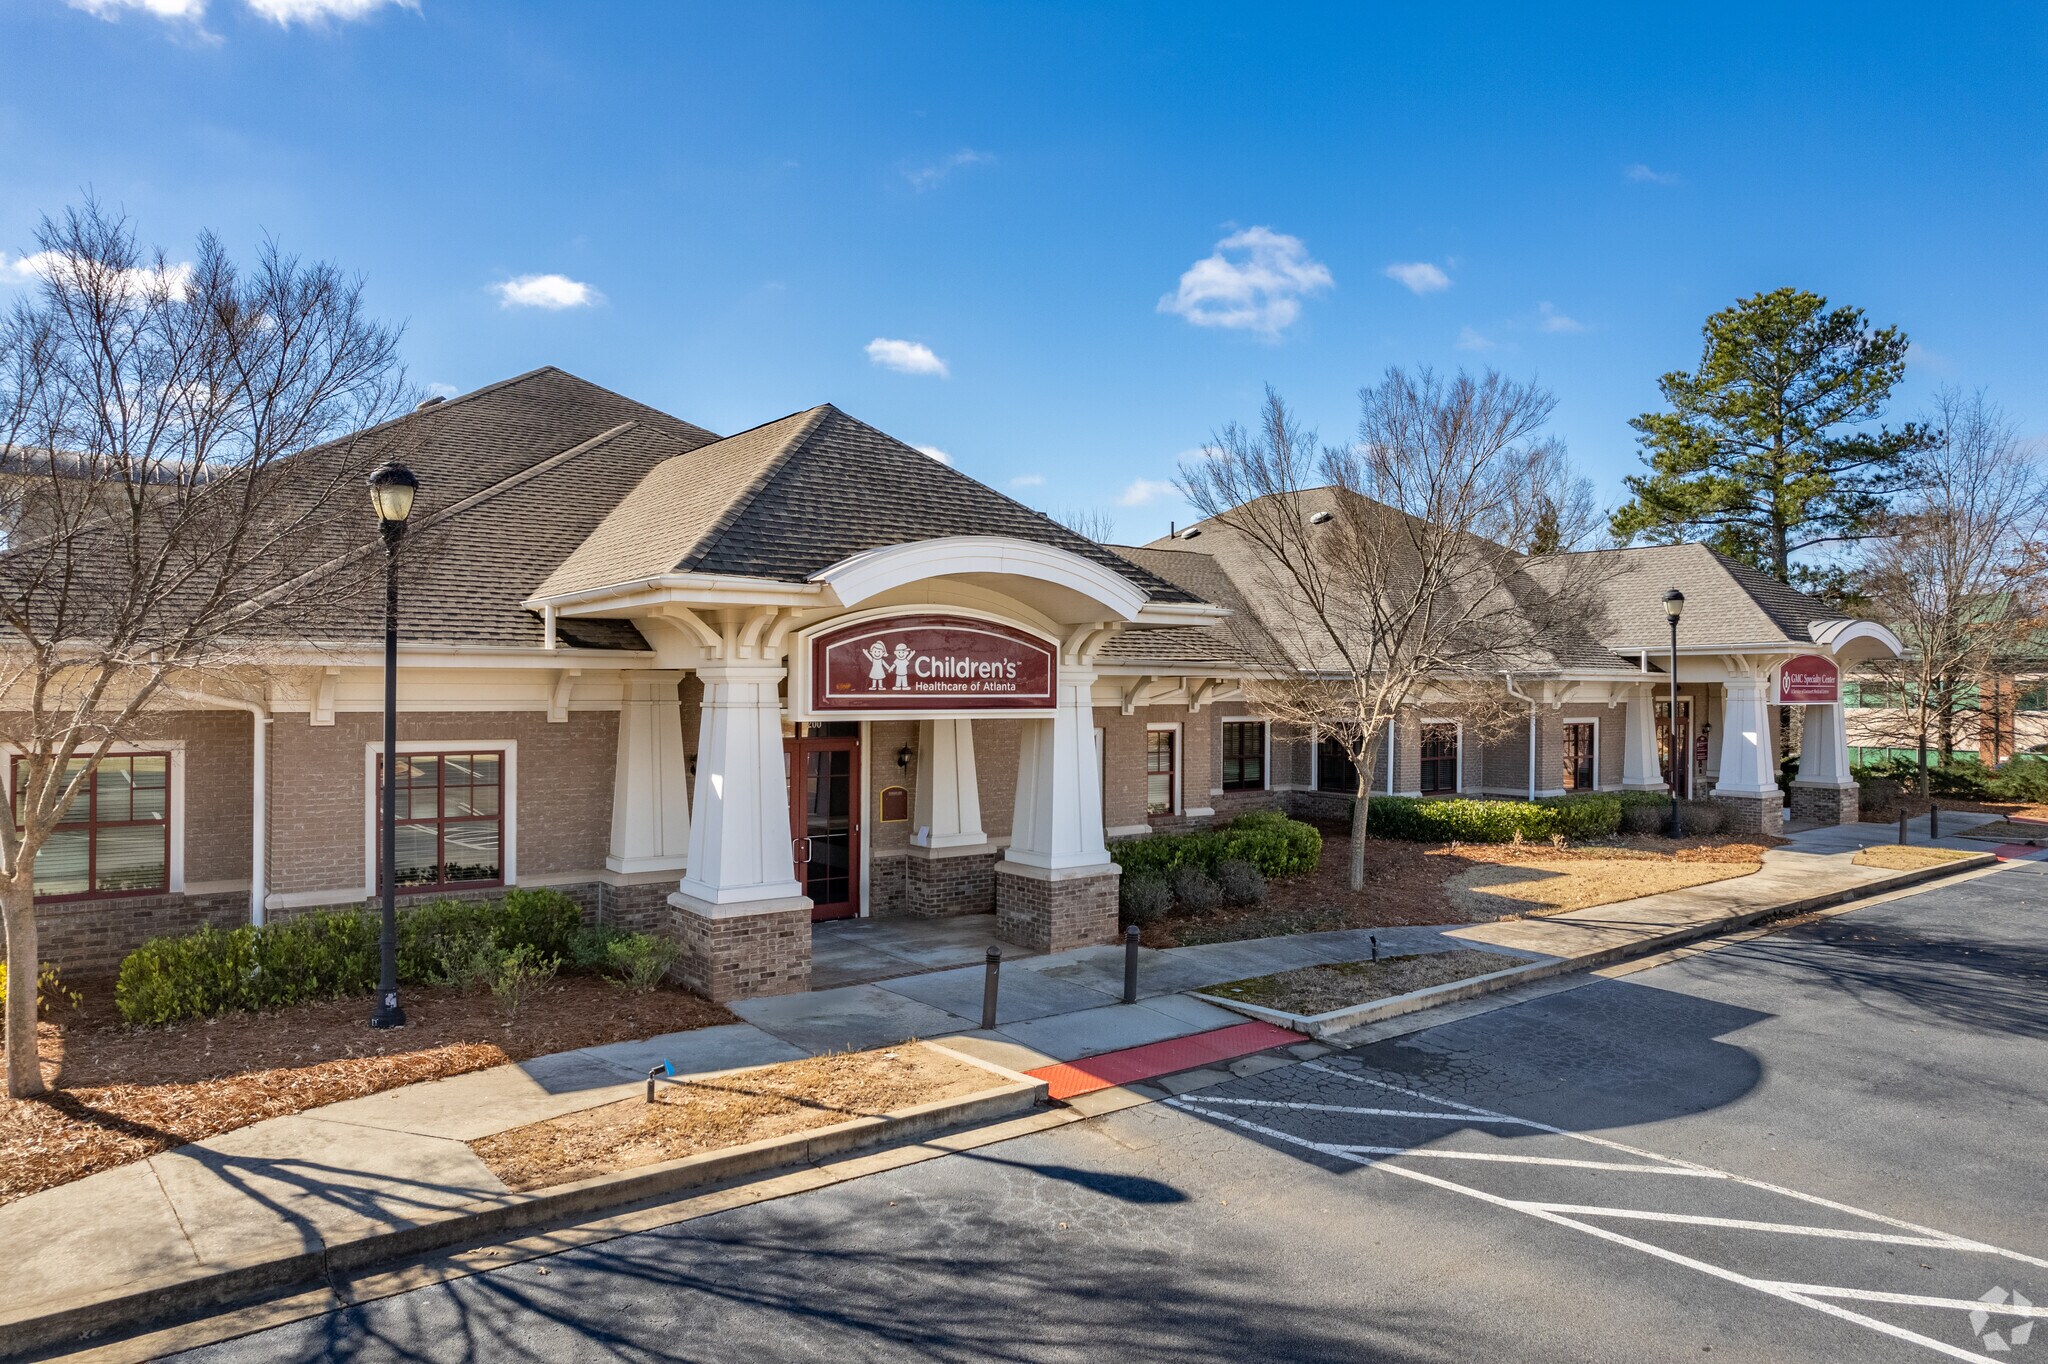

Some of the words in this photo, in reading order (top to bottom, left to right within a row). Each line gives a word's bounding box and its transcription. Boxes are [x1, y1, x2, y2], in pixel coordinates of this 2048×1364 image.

[915, 656, 1016, 678] Children's
[1791, 673, 1804, 683] GMC
[1804, 673, 1821, 685] Specialty
[1821, 674, 1836, 683] Center
[915, 681, 967, 691] Healthcare
[970, 681, 981, 691] of
[983, 681, 1016, 691] Atlanta
[808, 721, 822, 729] 200
